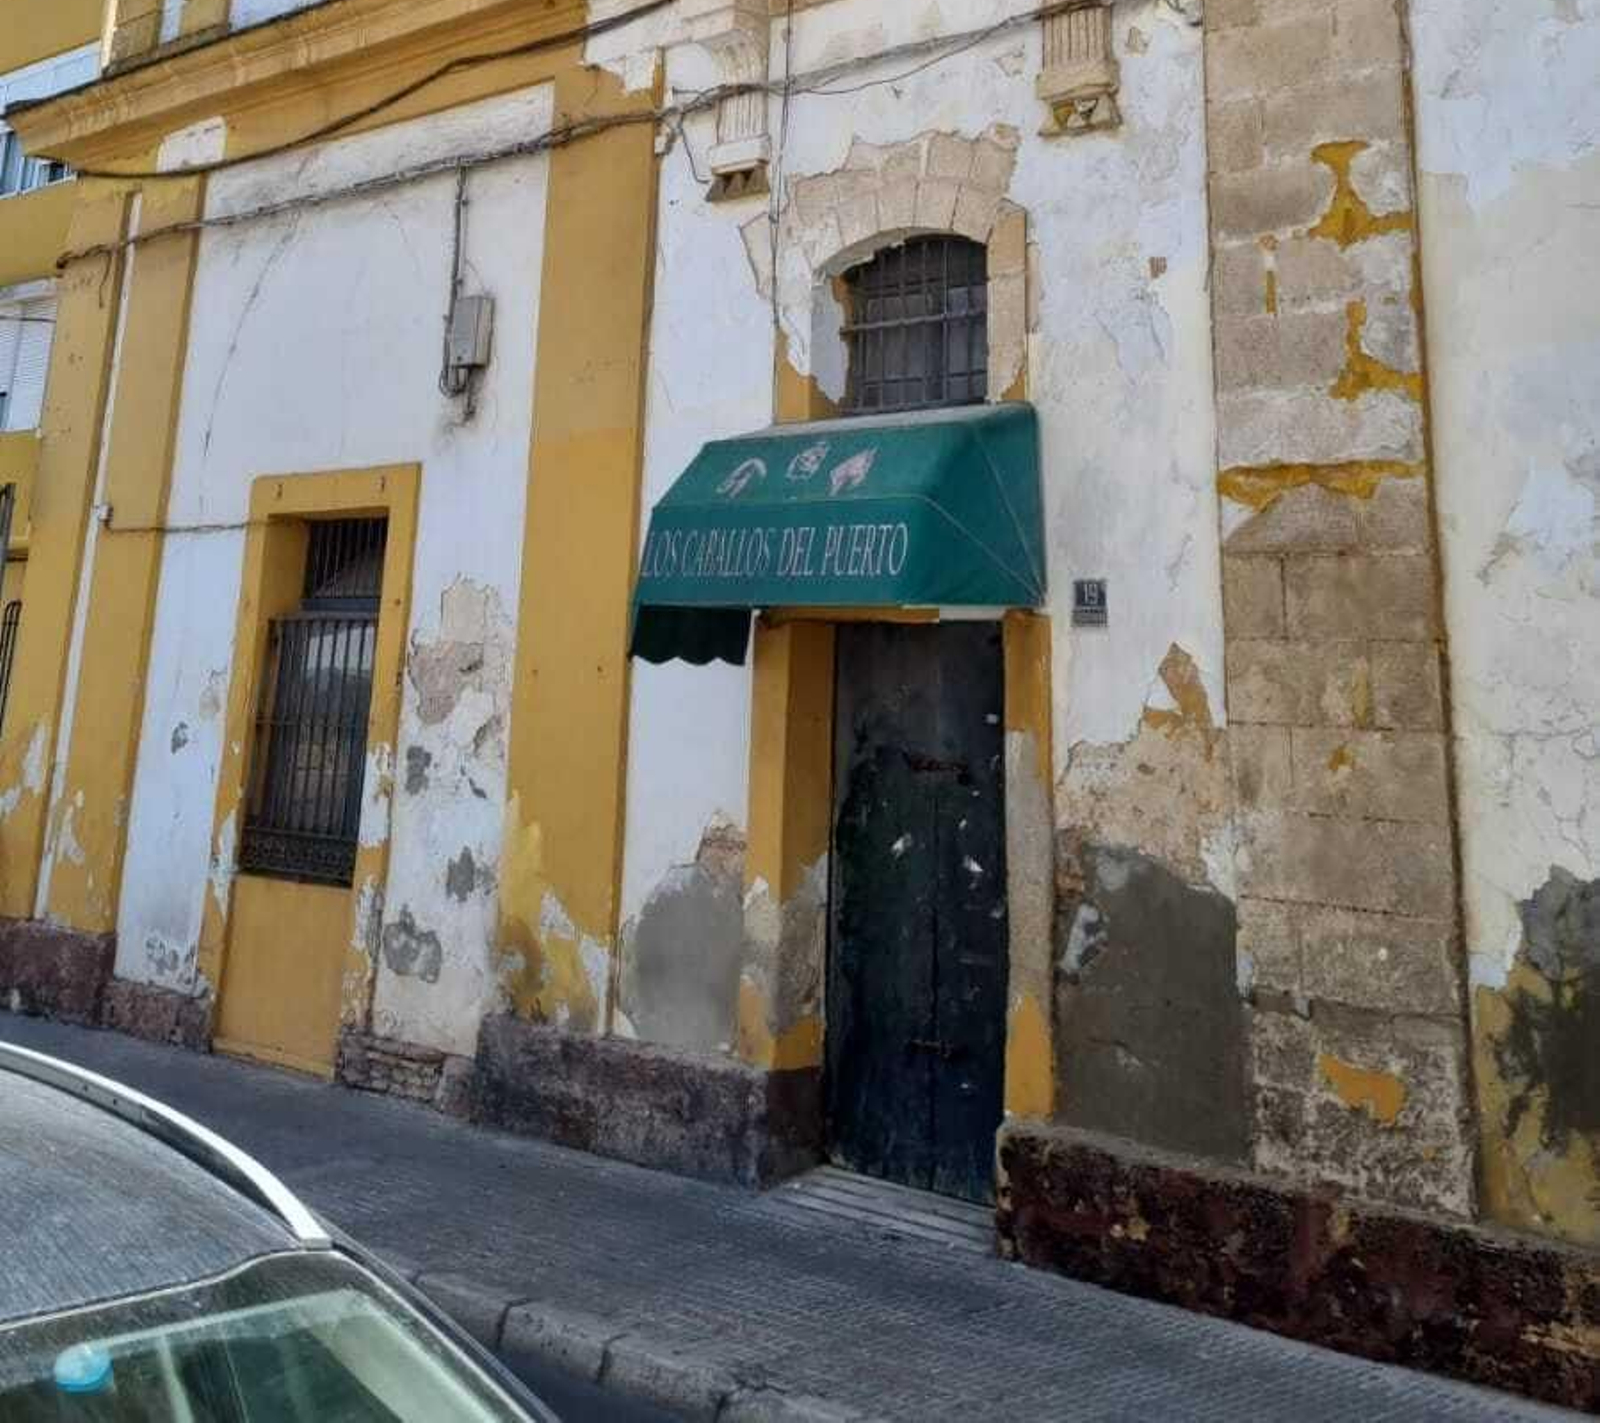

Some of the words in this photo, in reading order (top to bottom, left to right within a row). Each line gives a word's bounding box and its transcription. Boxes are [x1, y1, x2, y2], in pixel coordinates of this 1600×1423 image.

[641, 528, 682, 577] LOS
[681, 526, 776, 577] CABALLOS
[777, 526, 816, 577] DEL
[821, 522, 909, 576] PUERTO
[1083, 583, 1098, 605] 19
